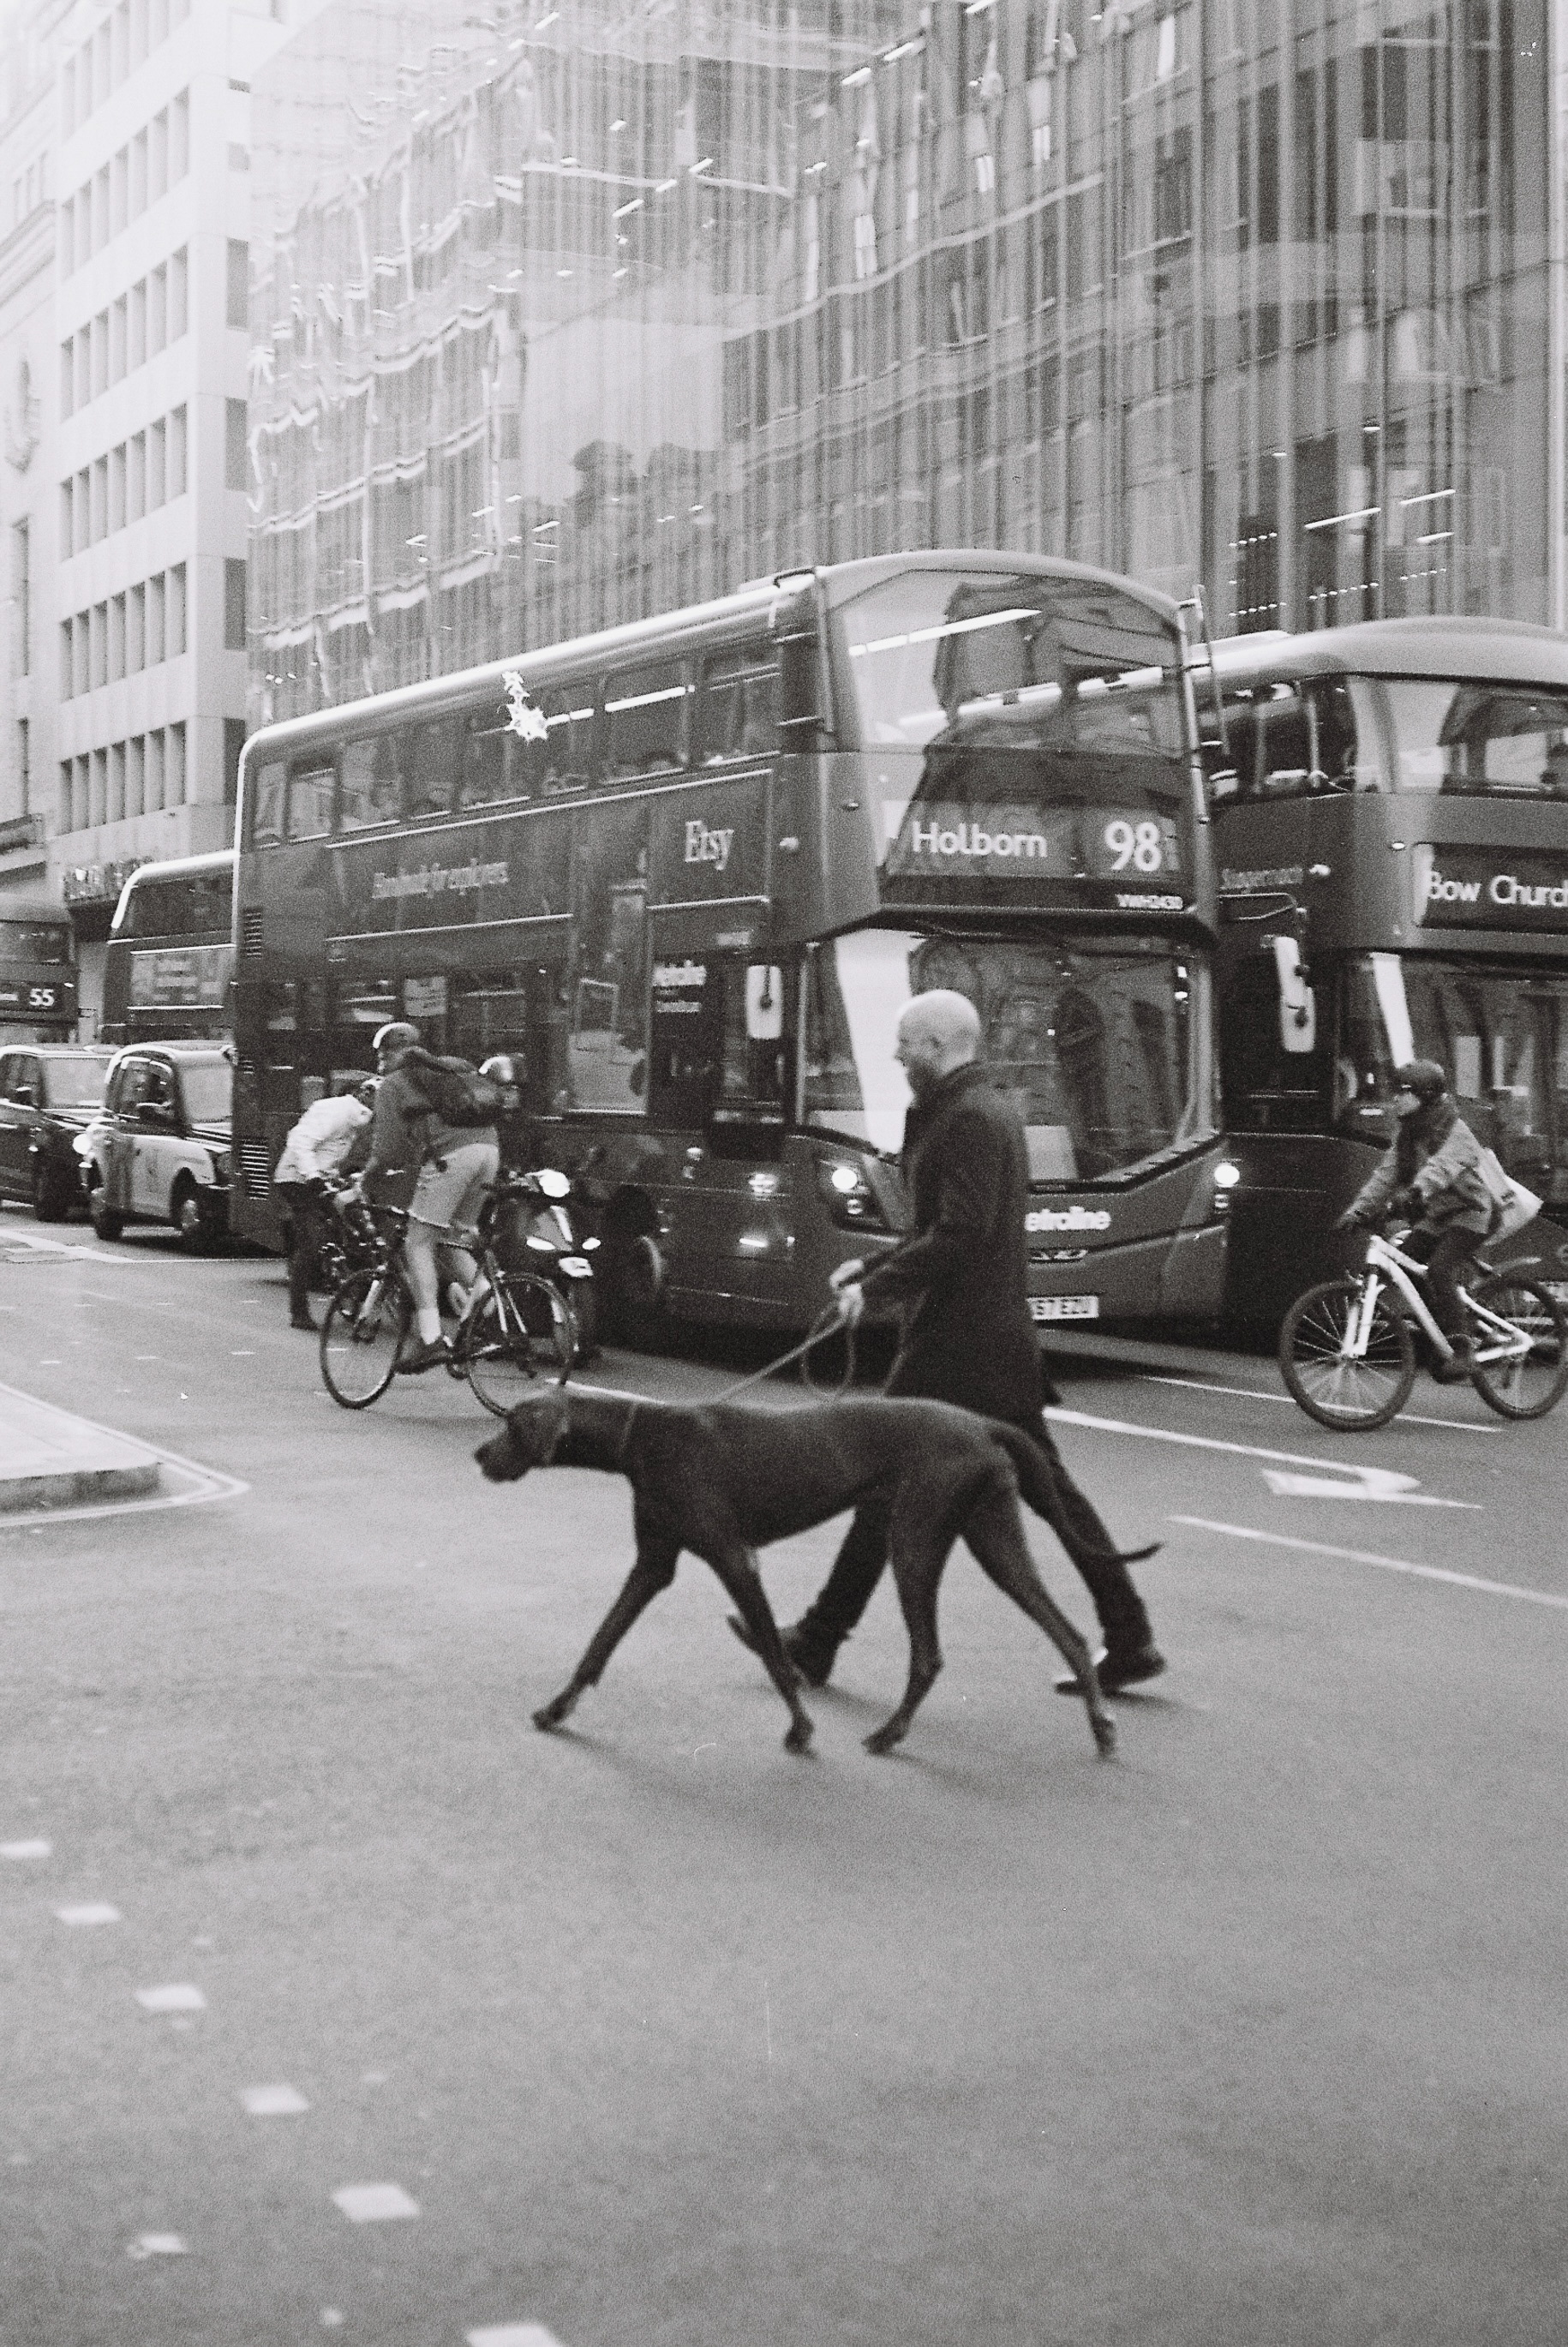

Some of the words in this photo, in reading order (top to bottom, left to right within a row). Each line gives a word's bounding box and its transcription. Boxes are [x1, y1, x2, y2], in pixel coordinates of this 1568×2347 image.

[912, 820, 1048, 858] Holborn
[1104, 819, 1162, 872] 98
[28, 988, 56, 1007] 55
